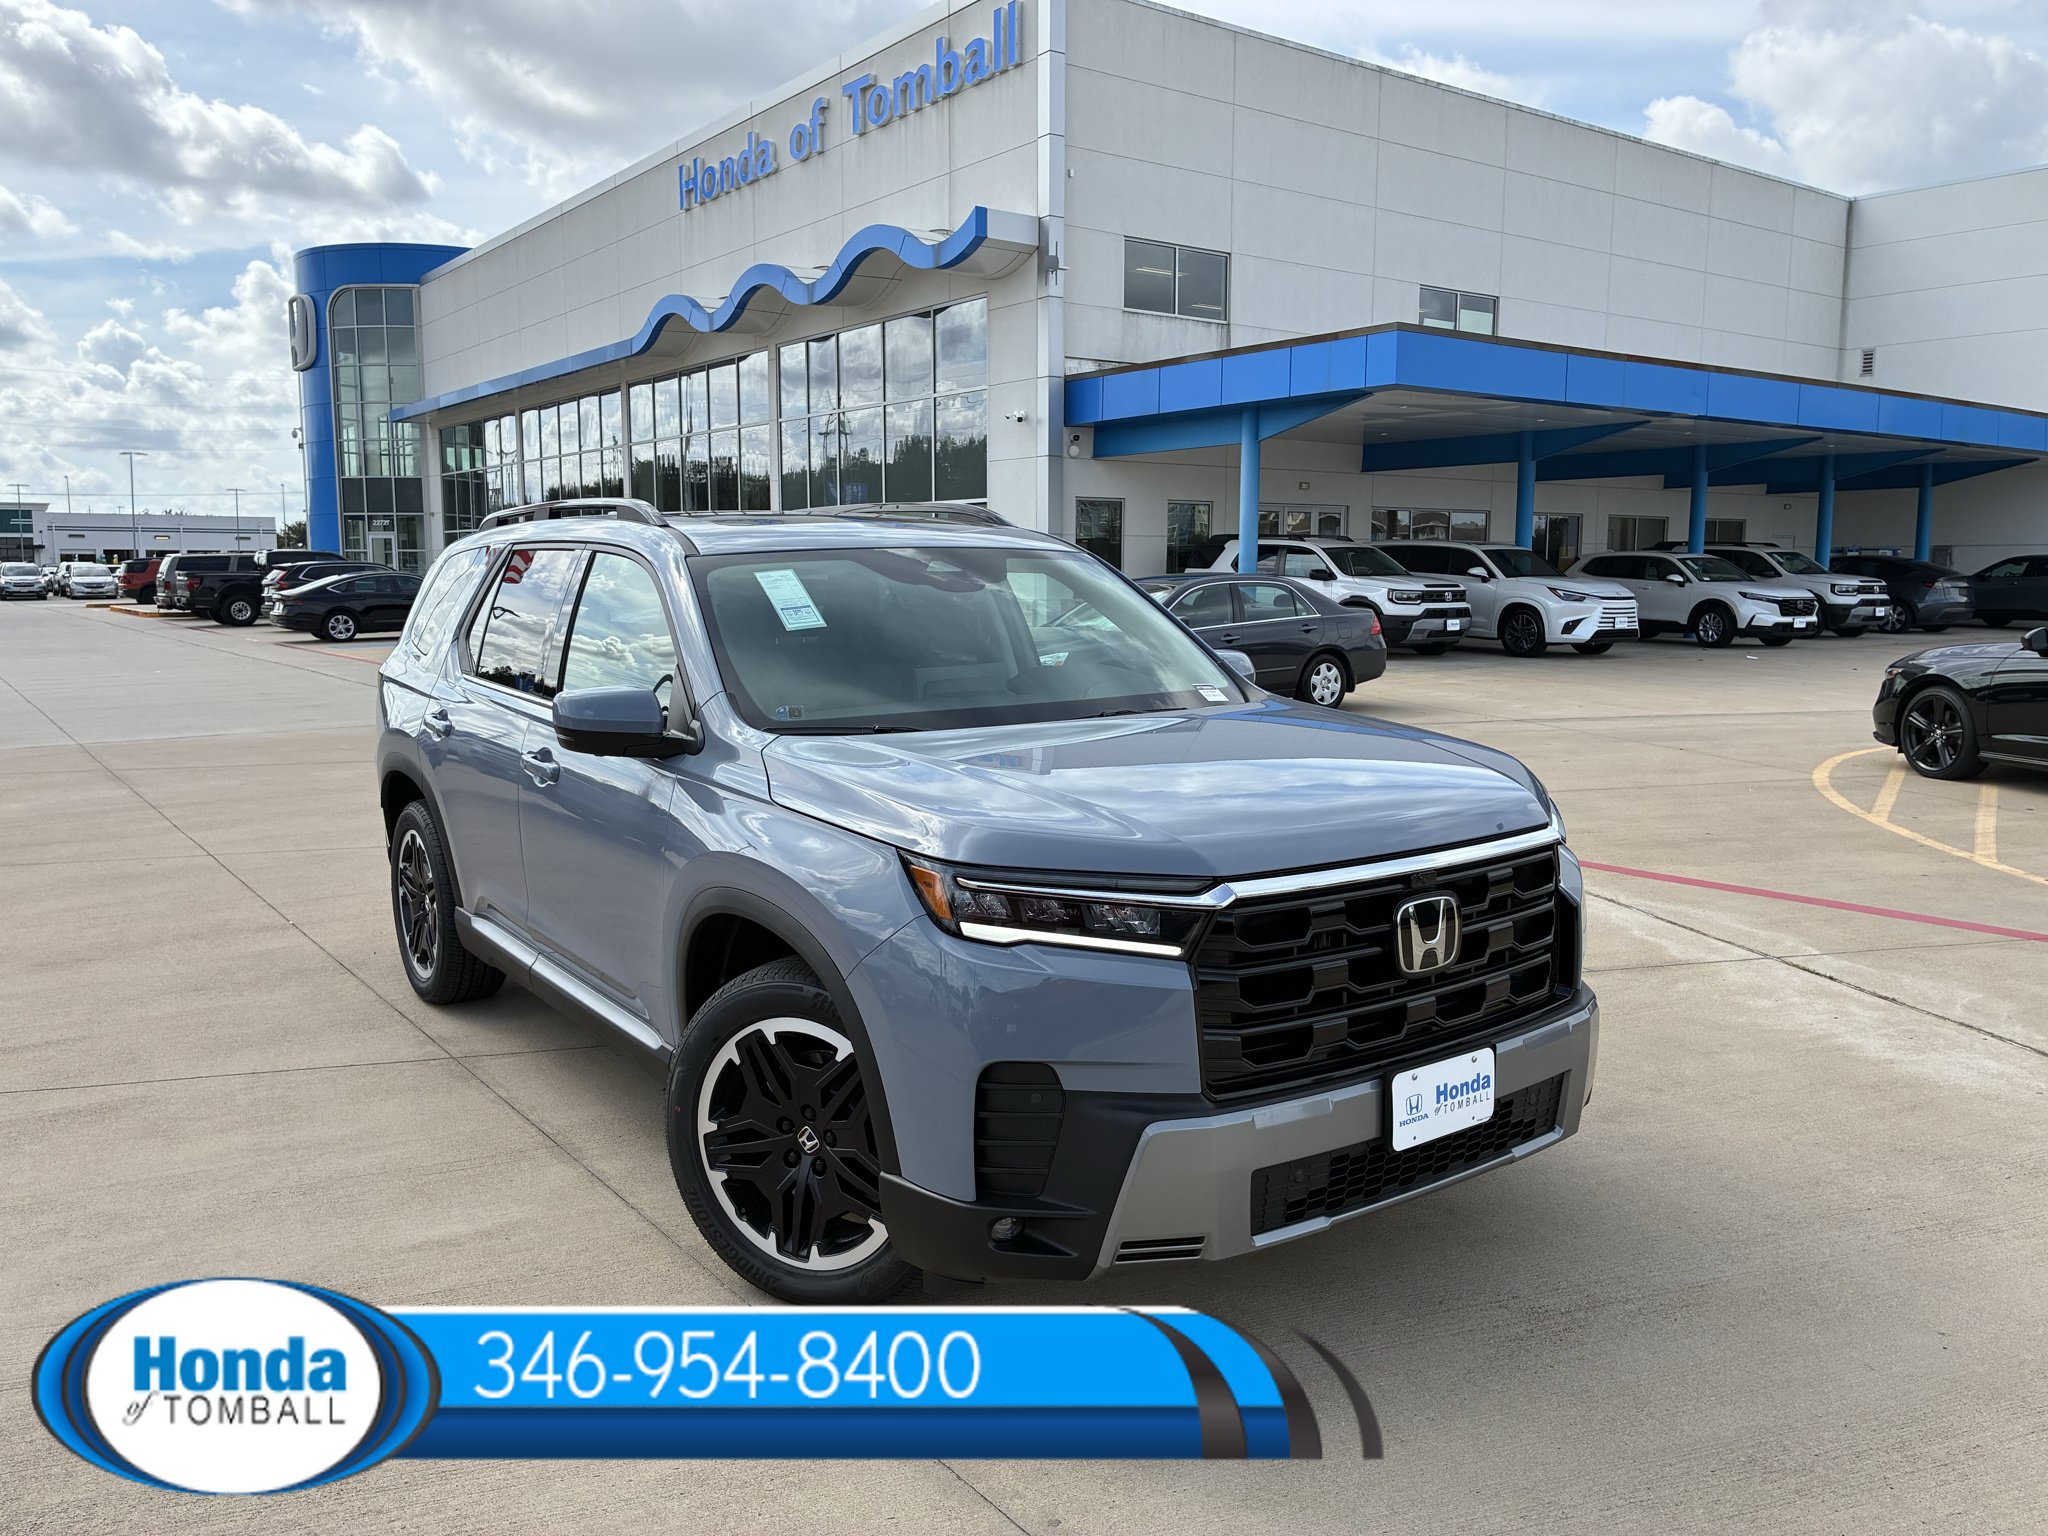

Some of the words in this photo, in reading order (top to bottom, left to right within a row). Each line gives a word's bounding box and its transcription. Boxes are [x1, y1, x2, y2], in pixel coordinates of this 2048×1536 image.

[678, 130, 778, 211] Honda
[789, 97, 830, 161] of
[842, 0, 1022, 136] Tomball
[1436, 1073, 1491, 1104] Honda
[1444, 1091, 1490, 1114] TOMBALL
[1399, 1113, 1429, 1127] HONDA
[683, 1184, 781, 1292] BRIDGESTONE
